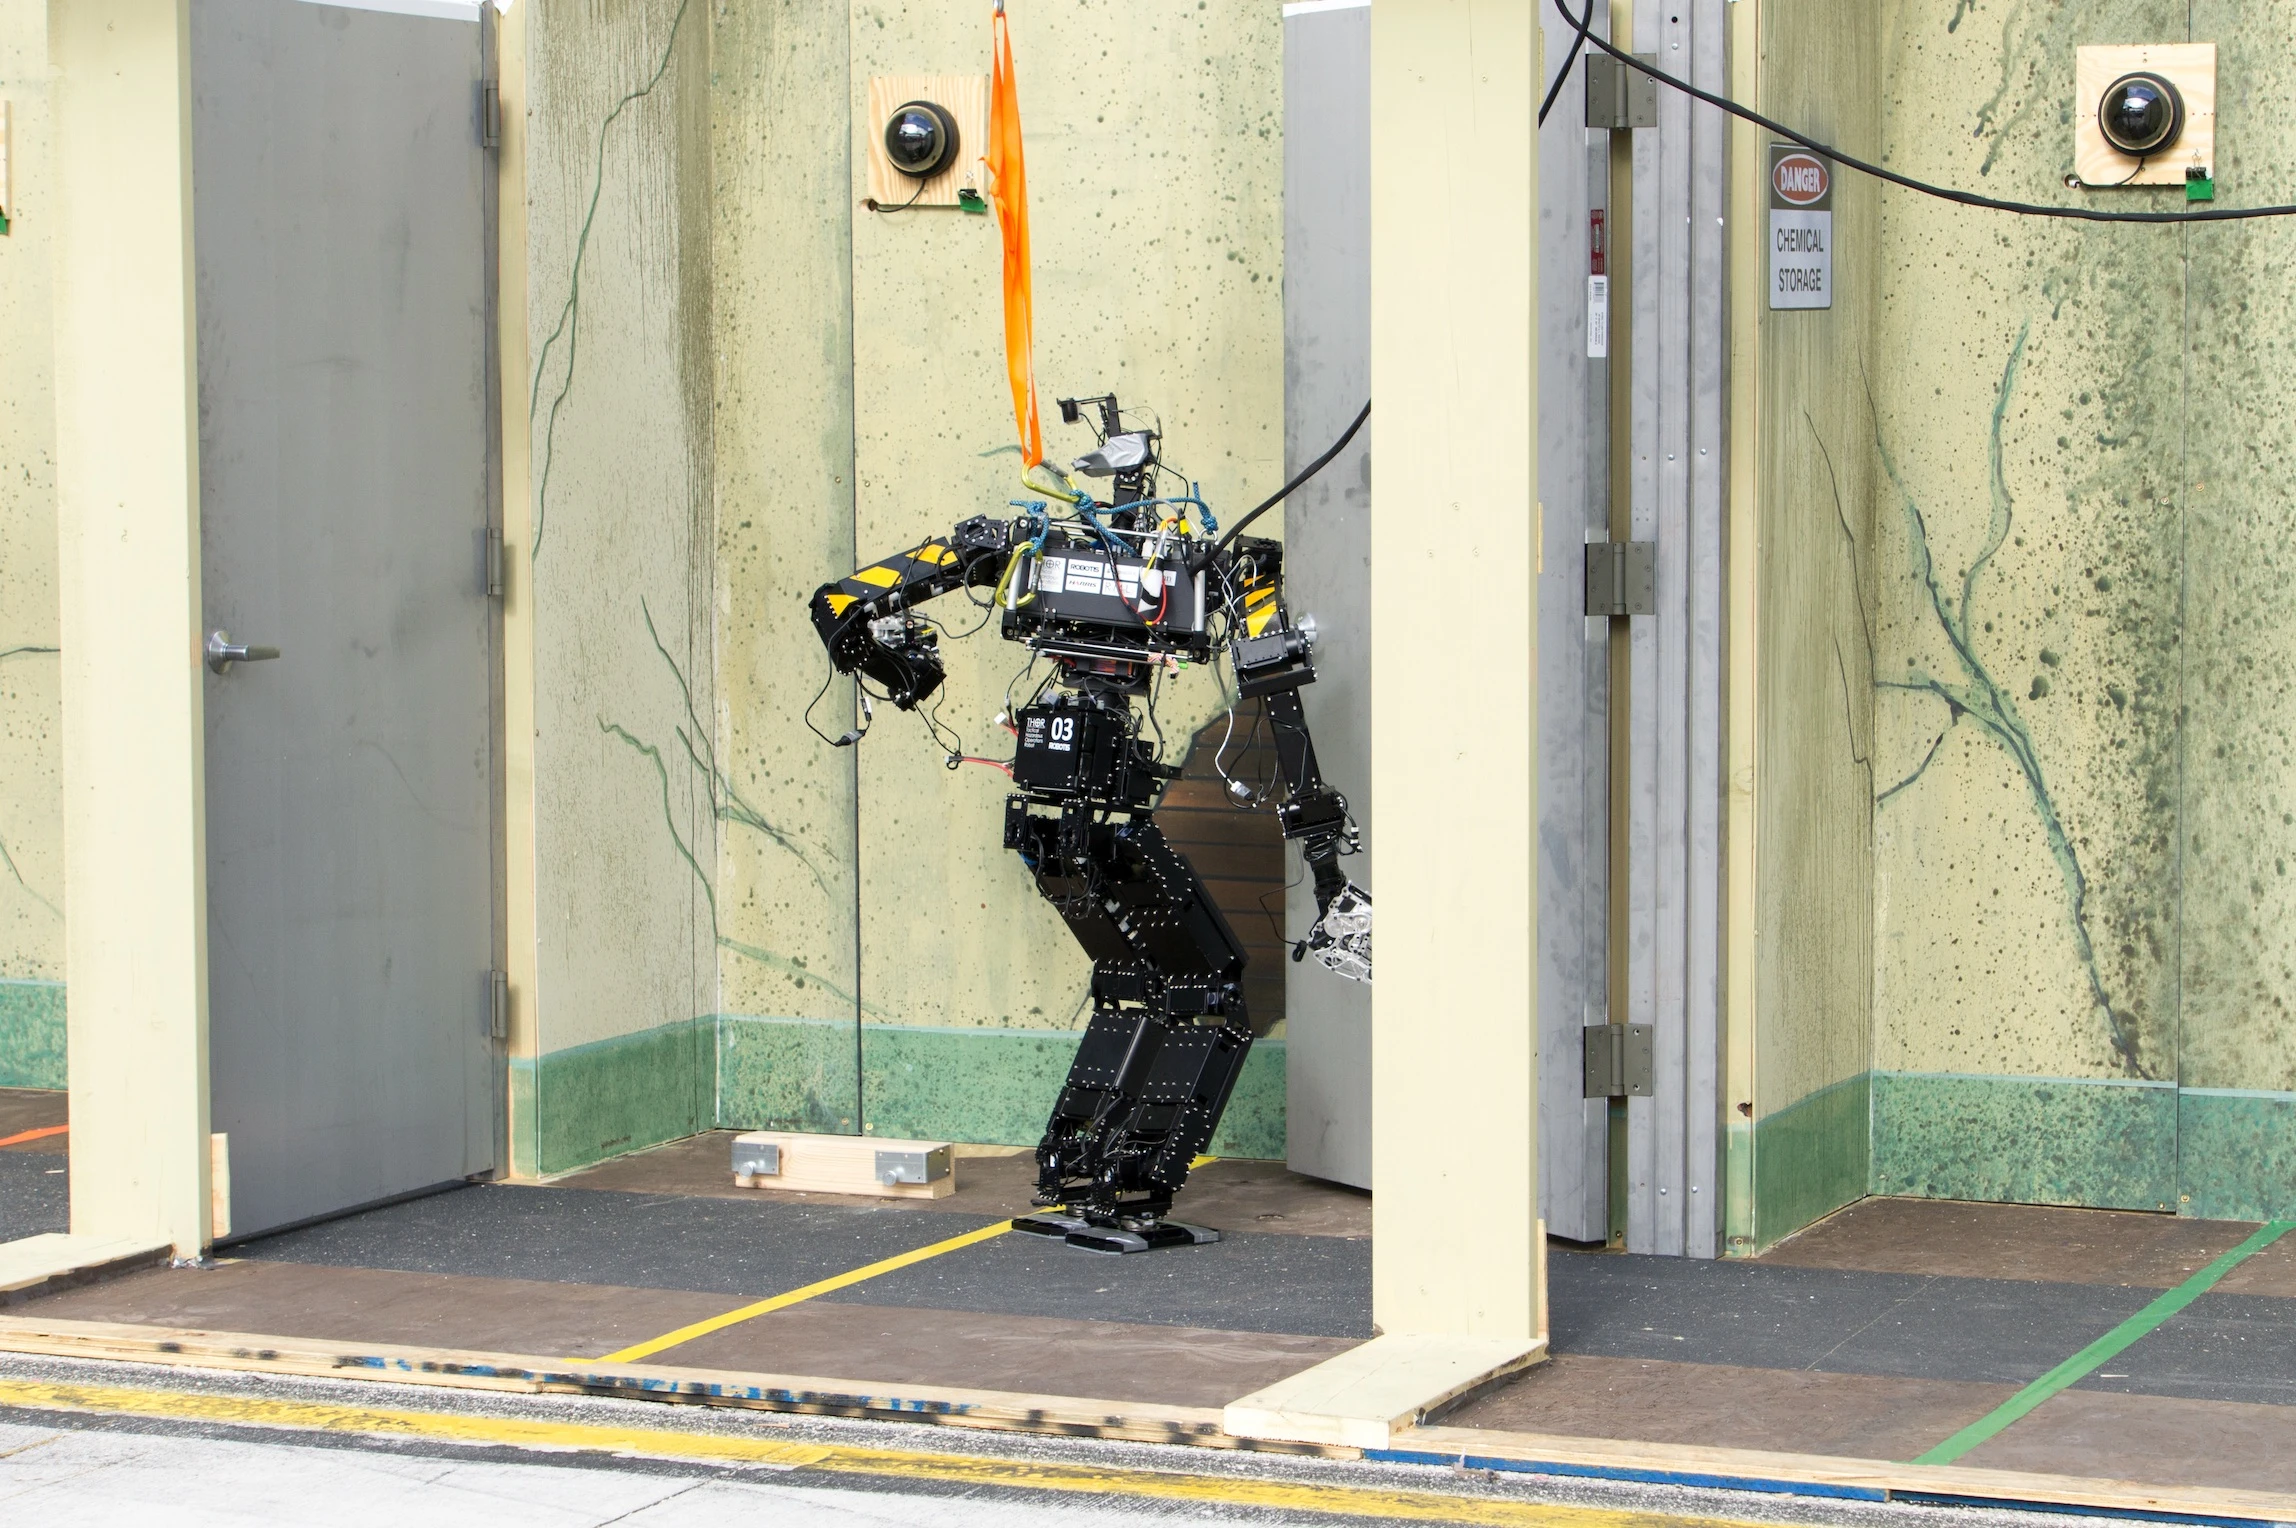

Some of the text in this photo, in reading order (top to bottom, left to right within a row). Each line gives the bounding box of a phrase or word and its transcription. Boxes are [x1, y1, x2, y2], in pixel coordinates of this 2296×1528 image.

[1780, 165, 1820, 193] DANGER
[1777, 228, 1824, 253] CHEMICAL
[1778, 268, 1821, 292] STORAGE
[1027, 717, 1046, 729] THOR
[1051, 717, 1074, 742] 03
[1048, 742, 1071, 751] ROBOTIS
